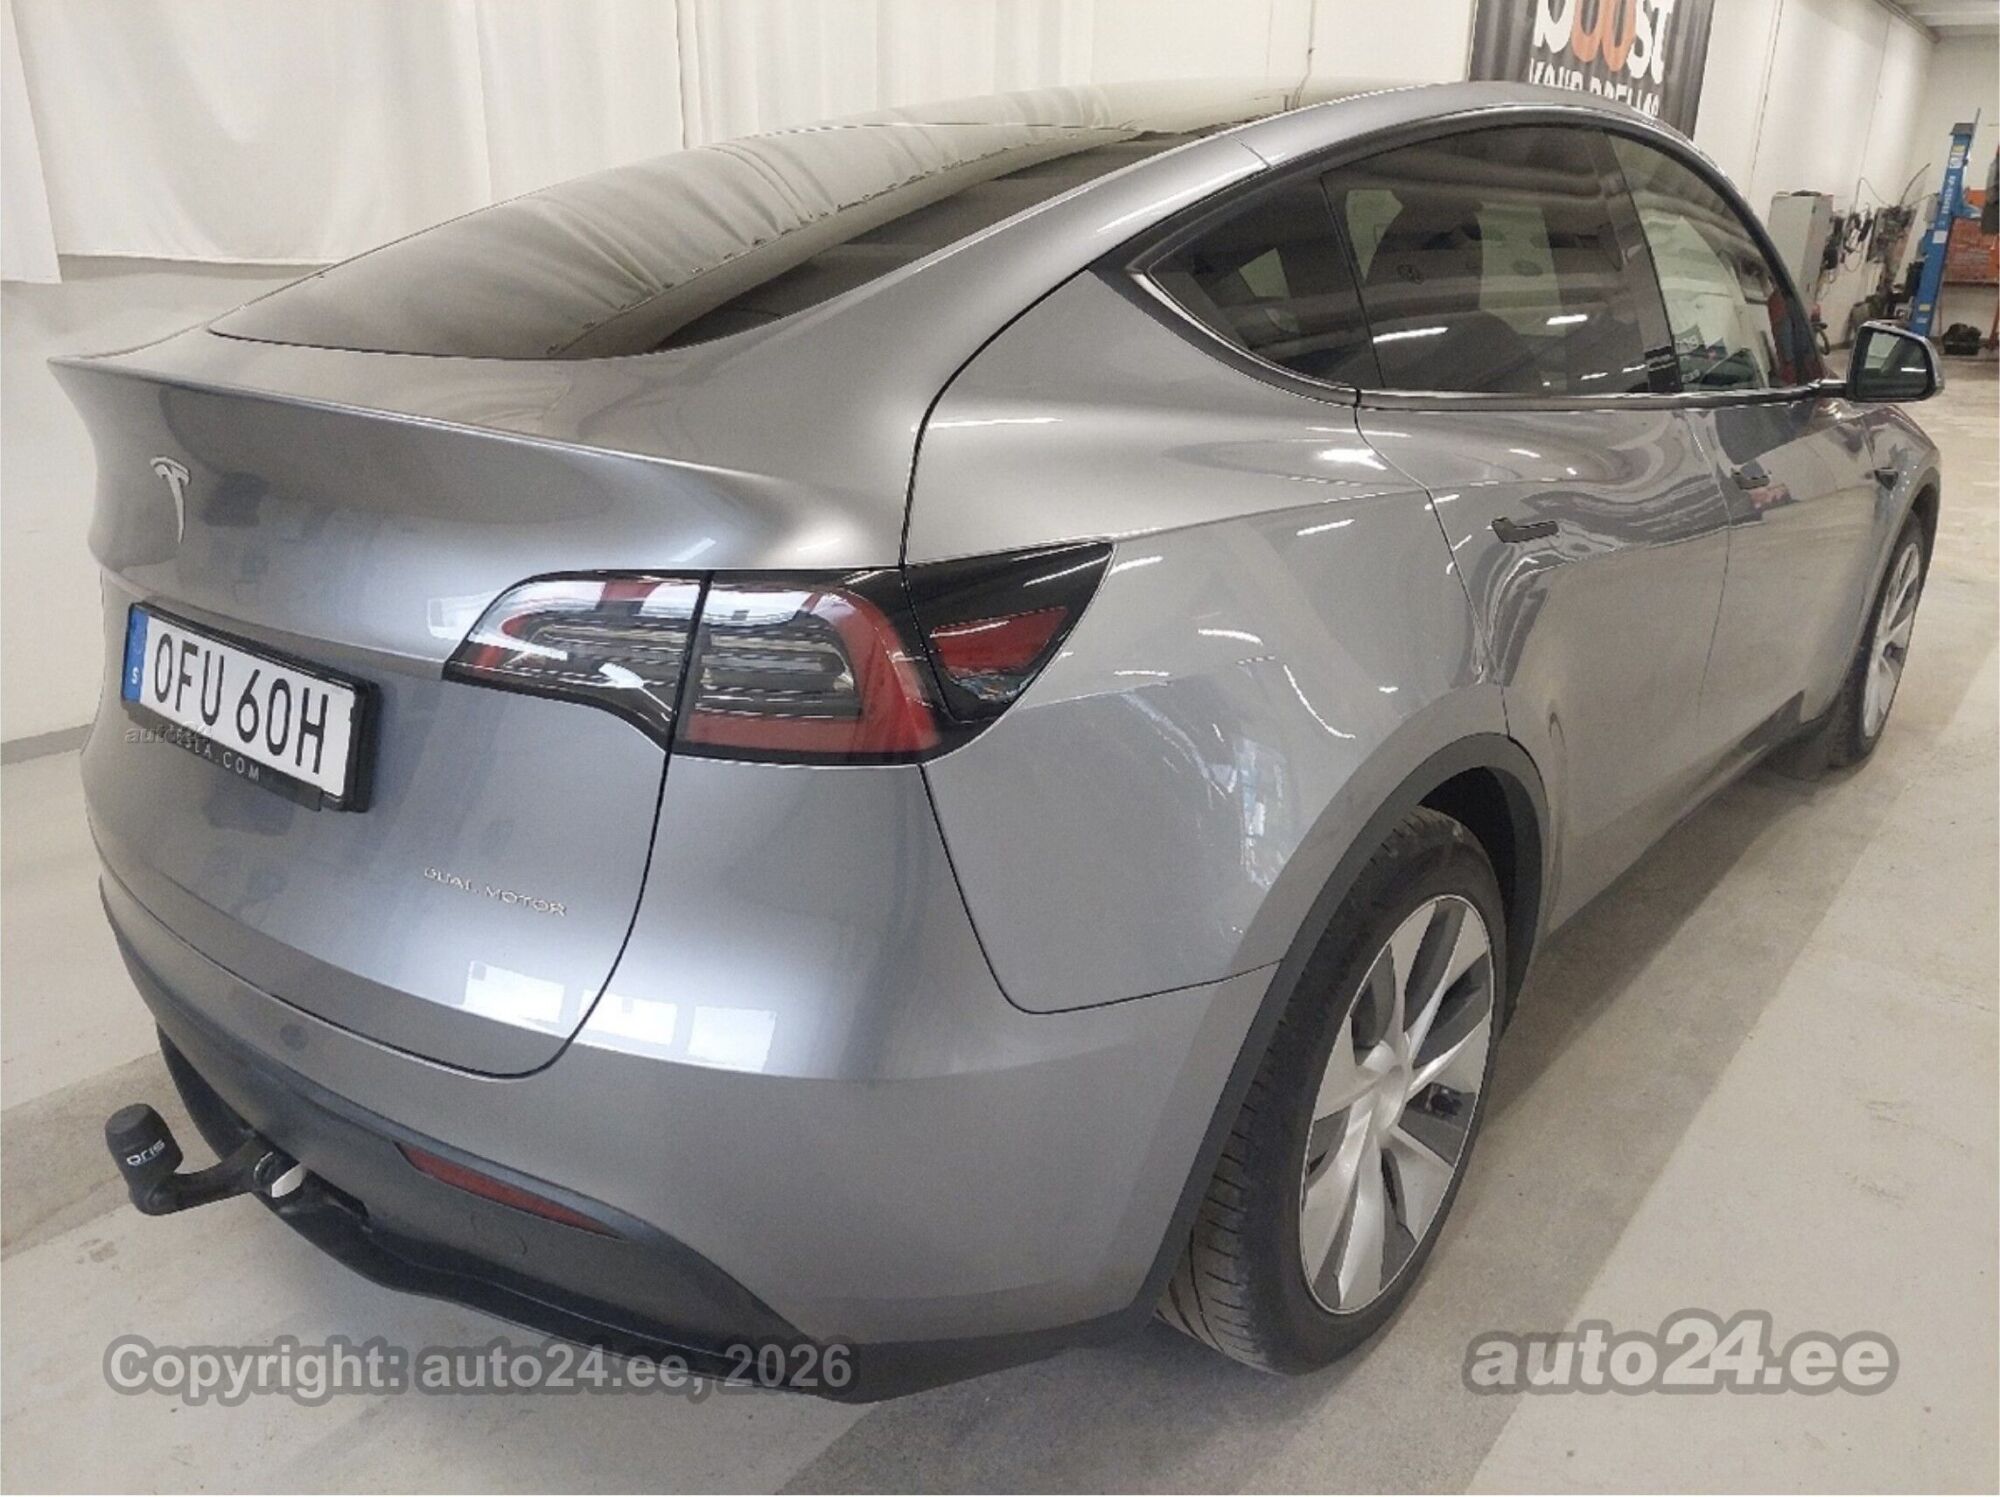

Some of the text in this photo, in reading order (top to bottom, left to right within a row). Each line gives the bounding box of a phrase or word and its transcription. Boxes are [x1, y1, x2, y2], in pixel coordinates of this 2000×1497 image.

[130, 667, 140, 685] S
[154, 633, 329, 774] OFU 60H
[424, 866, 567, 917] DUAL MOTOR
